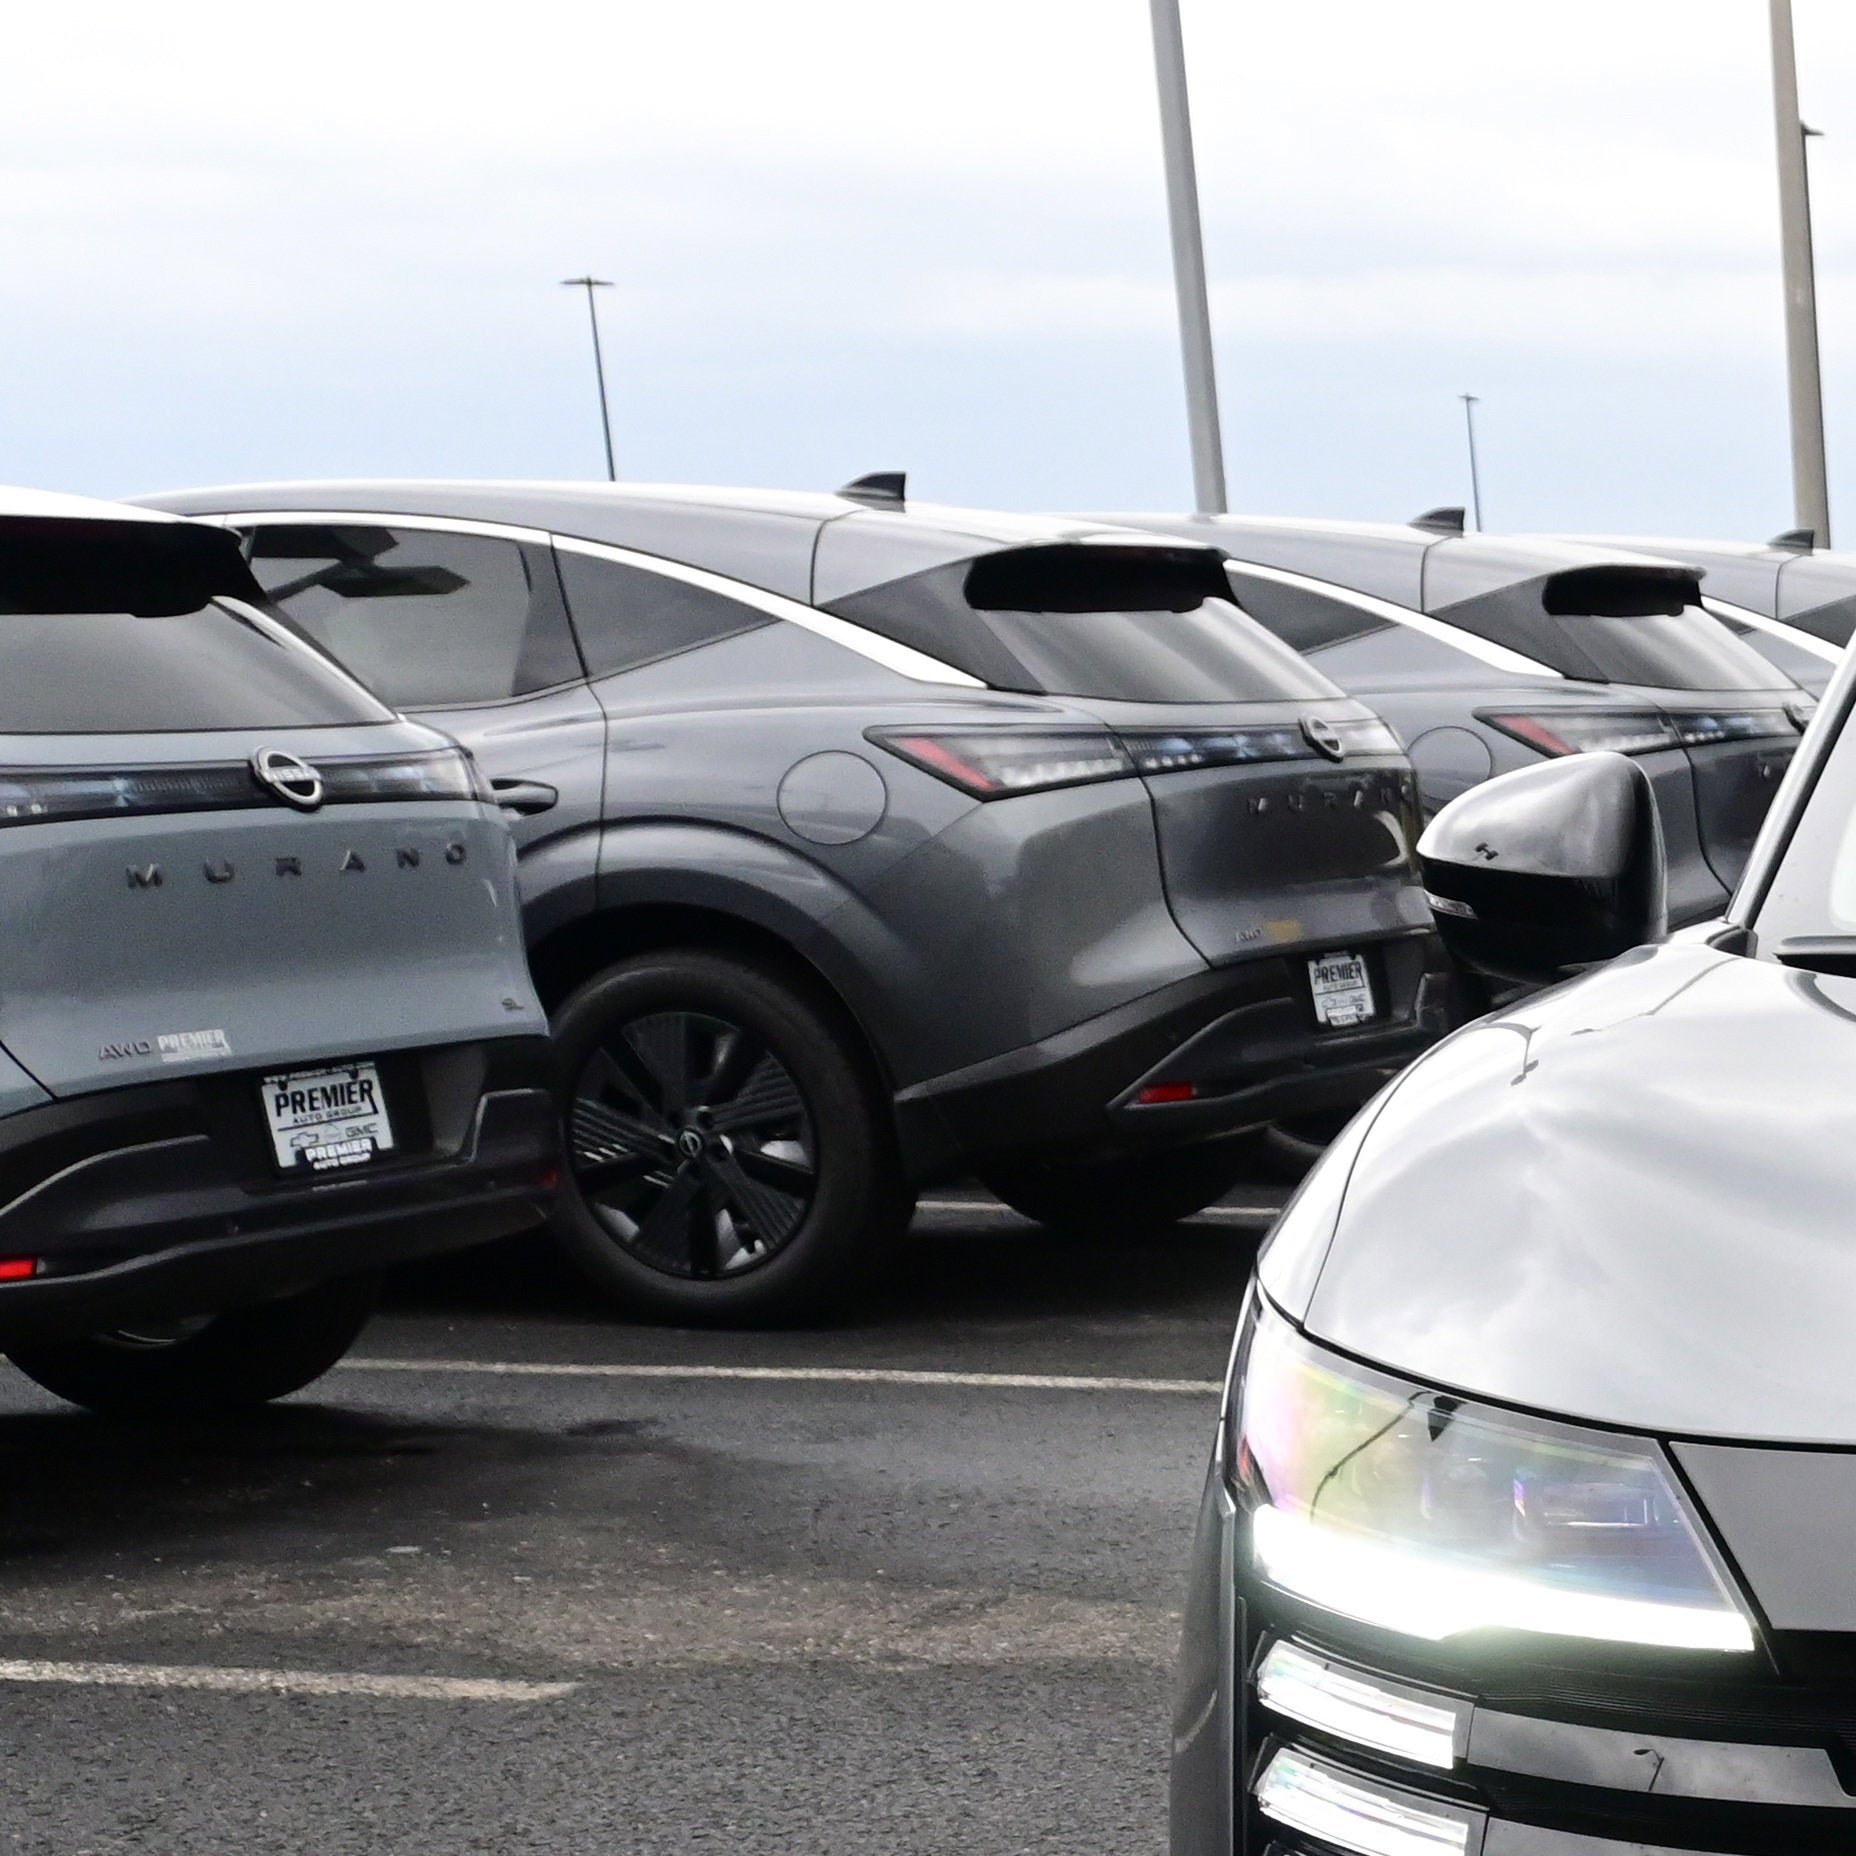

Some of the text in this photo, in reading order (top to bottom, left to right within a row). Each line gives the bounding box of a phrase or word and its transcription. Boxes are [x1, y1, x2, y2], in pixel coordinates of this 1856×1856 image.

[126, 843, 467, 888] MURANO
[99, 1041, 151, 1061] AWD
[274, 1079, 379, 1117] PREMIER
